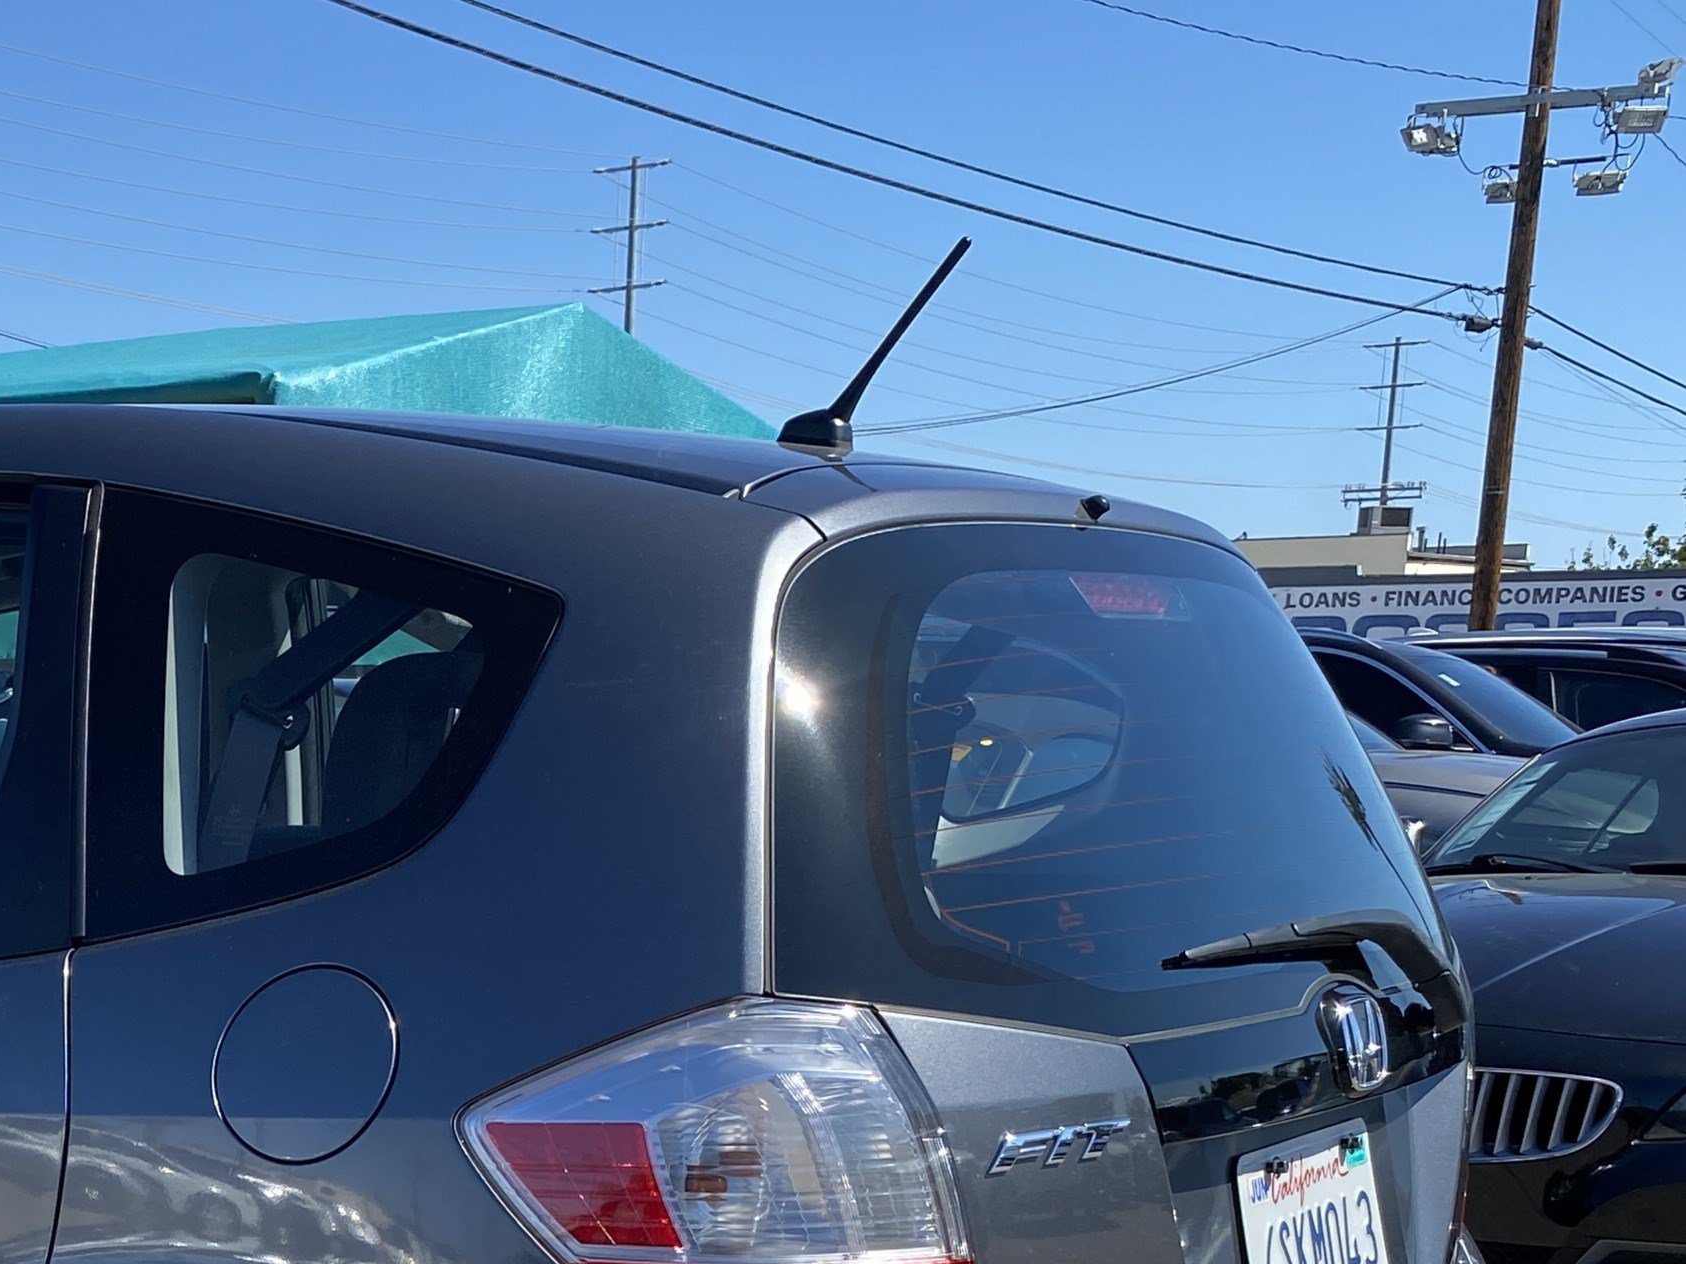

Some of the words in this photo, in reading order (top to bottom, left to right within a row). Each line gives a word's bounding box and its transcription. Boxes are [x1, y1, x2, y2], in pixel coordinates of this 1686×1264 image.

[1284, 591, 1361, 609] LOANS
[1384, 589, 1473, 607] FINANC
[1499, 584, 1646, 605] COMPANIES
[987, 1117, 1131, 1178] FIT
[1250, 1176, 1270, 1204] JUN
[1271, 1154, 1349, 1206] California
